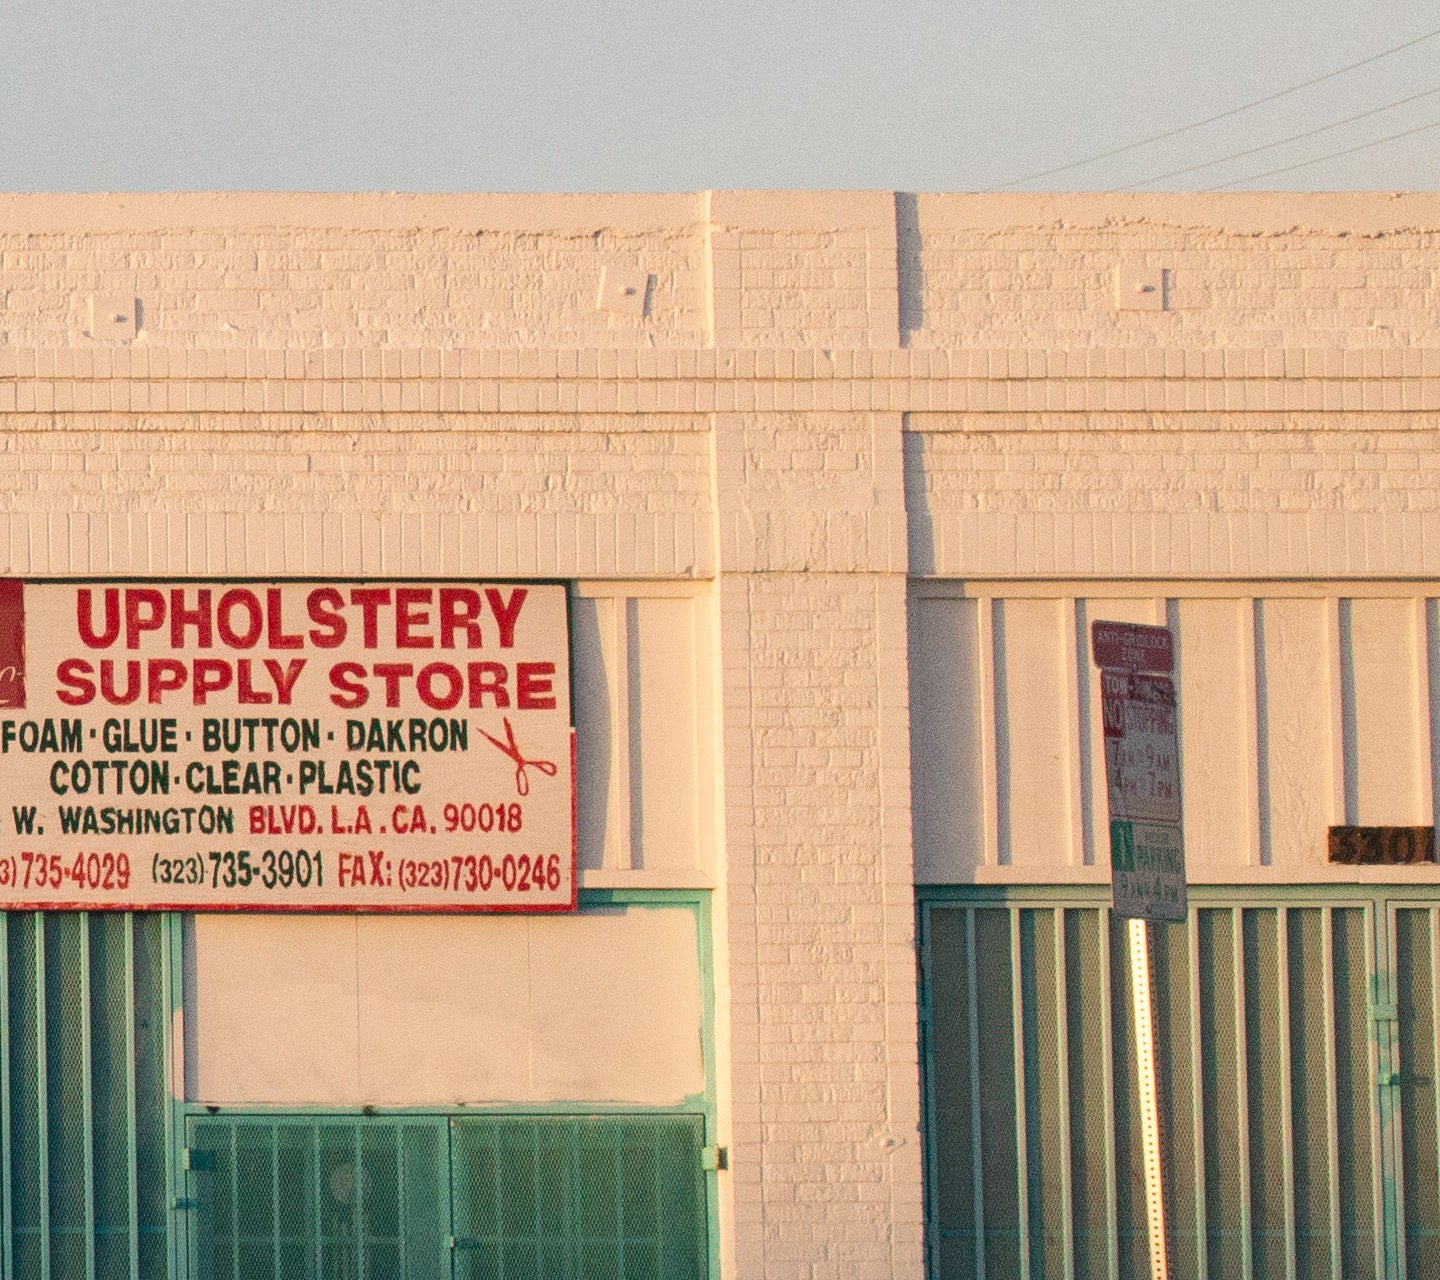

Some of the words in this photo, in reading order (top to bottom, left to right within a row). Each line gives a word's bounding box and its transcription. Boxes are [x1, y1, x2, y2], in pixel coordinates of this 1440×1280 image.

[77, 588, 528, 650] UPHOLSTERY
[56, 658, 307, 706] SUPPLY
[329, 661, 557, 711] STORE
[2, 719, 82, 754] FOAM
[103, 719, 177, 753] GLUE
[202, 718, 320, 753] BUTTON
[347, 718, 468, 752] DAKRON
[51, 760, 169, 795] COTTON
[186, 760, 281, 795] CLEAR
[299, 759, 421, 797] PLASTIC
[12, 806, 44, 835] W.
[59, 805, 234, 835] WASHINGTON
[249, 805, 323, 835] BLVD.
[443, 803, 522, 833] 90018
[1330, 826, 1436, 865] 3301
[338, 851, 392, 888] FAX:
